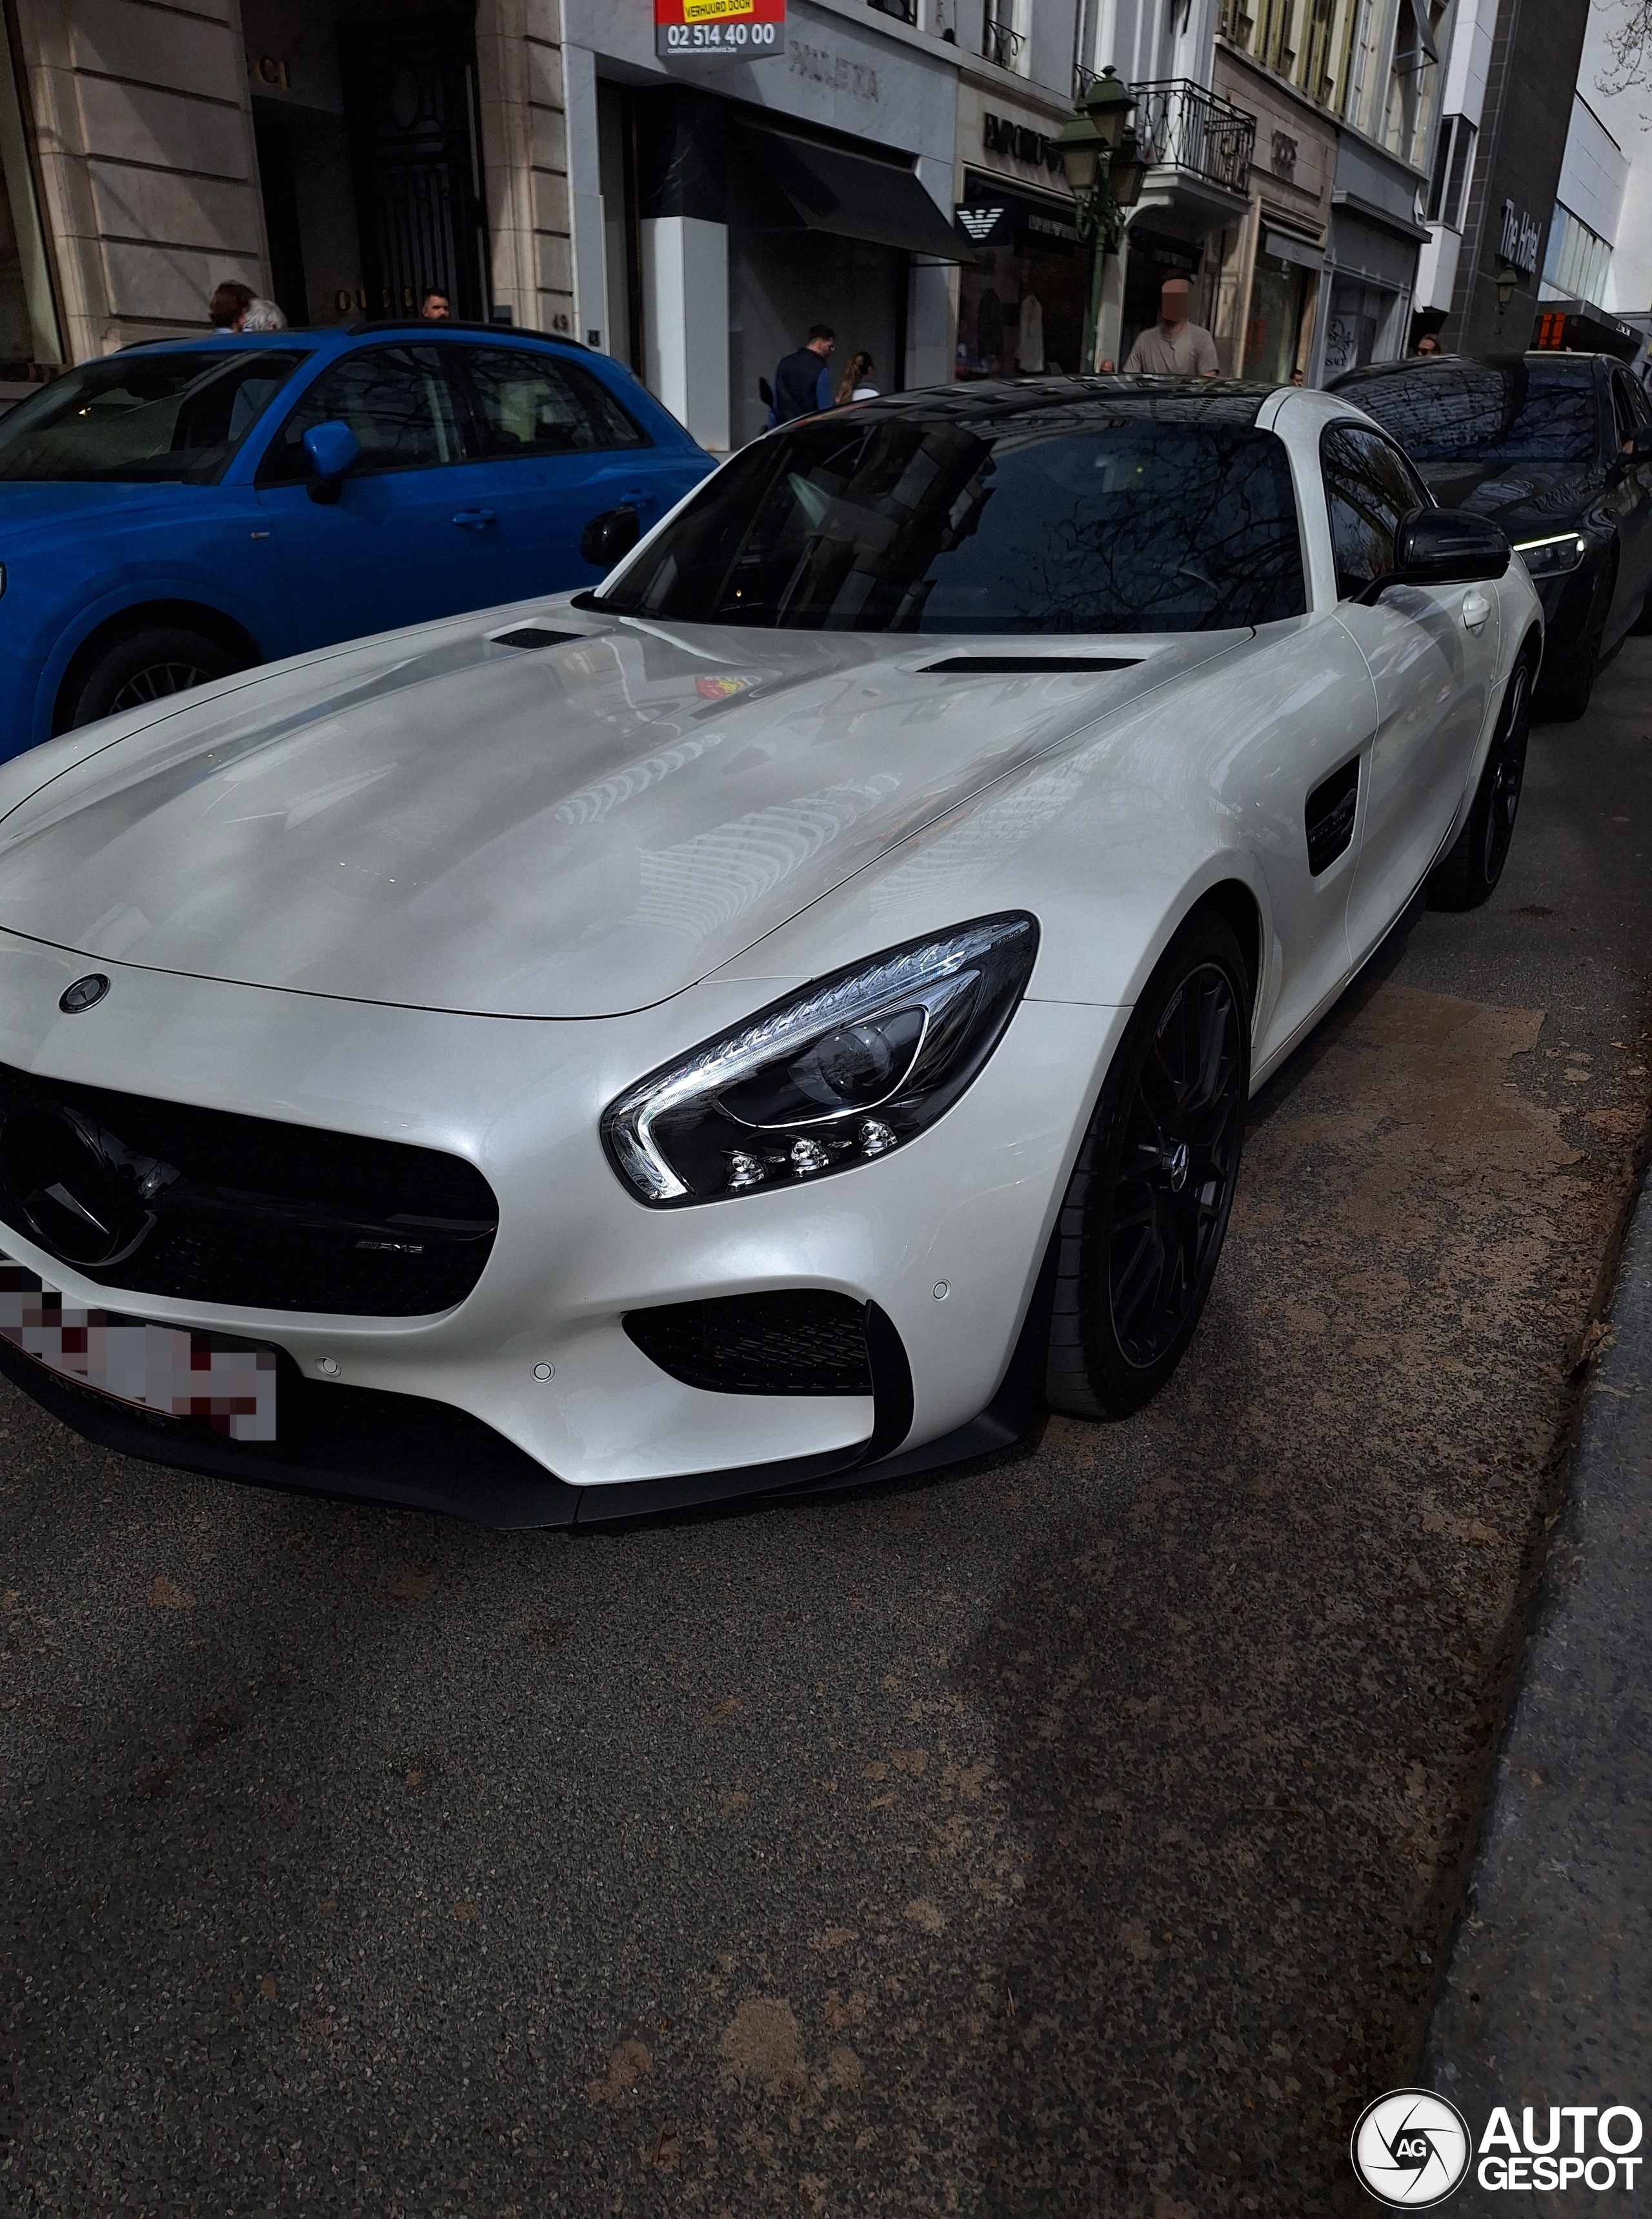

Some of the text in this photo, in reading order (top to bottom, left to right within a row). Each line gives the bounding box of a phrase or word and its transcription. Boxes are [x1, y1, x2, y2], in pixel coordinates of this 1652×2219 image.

[685, 0, 751, 18] VERHUURD DOOR
[667, 23, 776, 46] 02 514 40 00
[1500, 197, 1542, 274] The Hotel
